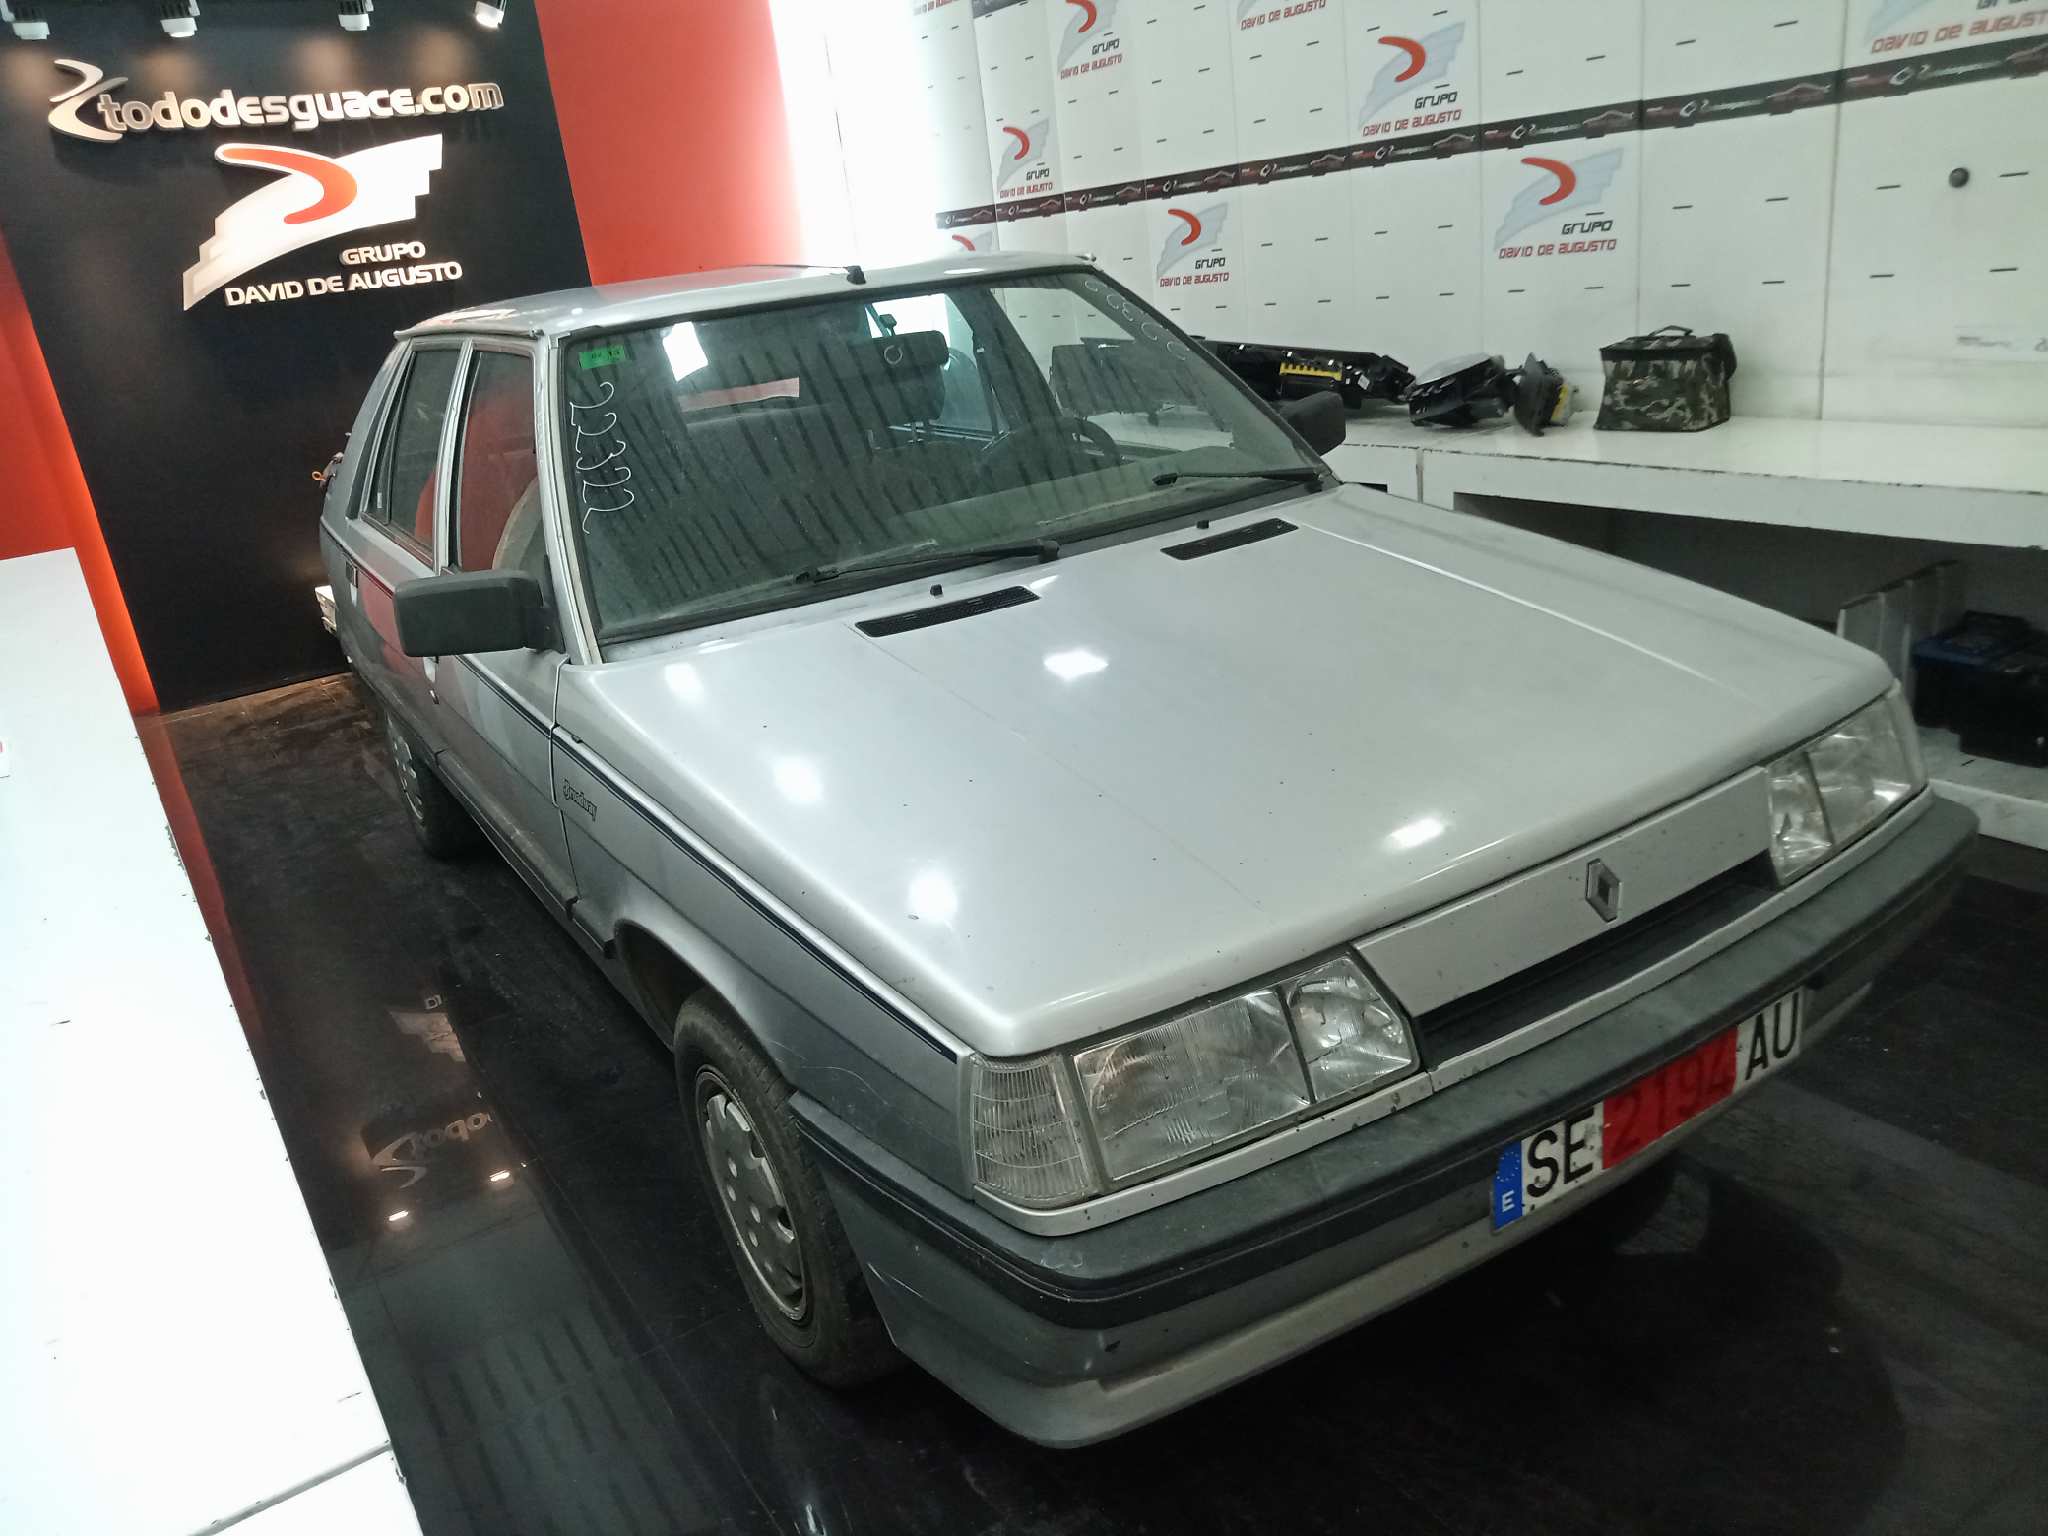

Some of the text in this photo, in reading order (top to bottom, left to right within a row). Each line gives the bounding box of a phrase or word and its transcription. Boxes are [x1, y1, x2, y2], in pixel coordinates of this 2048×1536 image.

[1968, 9, 2048, 36] AUGUST
[97, 82, 505, 132] tododesguace.com
[340, 241, 426, 265] GRUPO
[225, 261, 463, 306] DAVID DE AUGUSTO
[1526, 1106, 1595, 1198] SE
[1745, 991, 1799, 1080] AU
[1502, 1190, 1515, 1213] E
